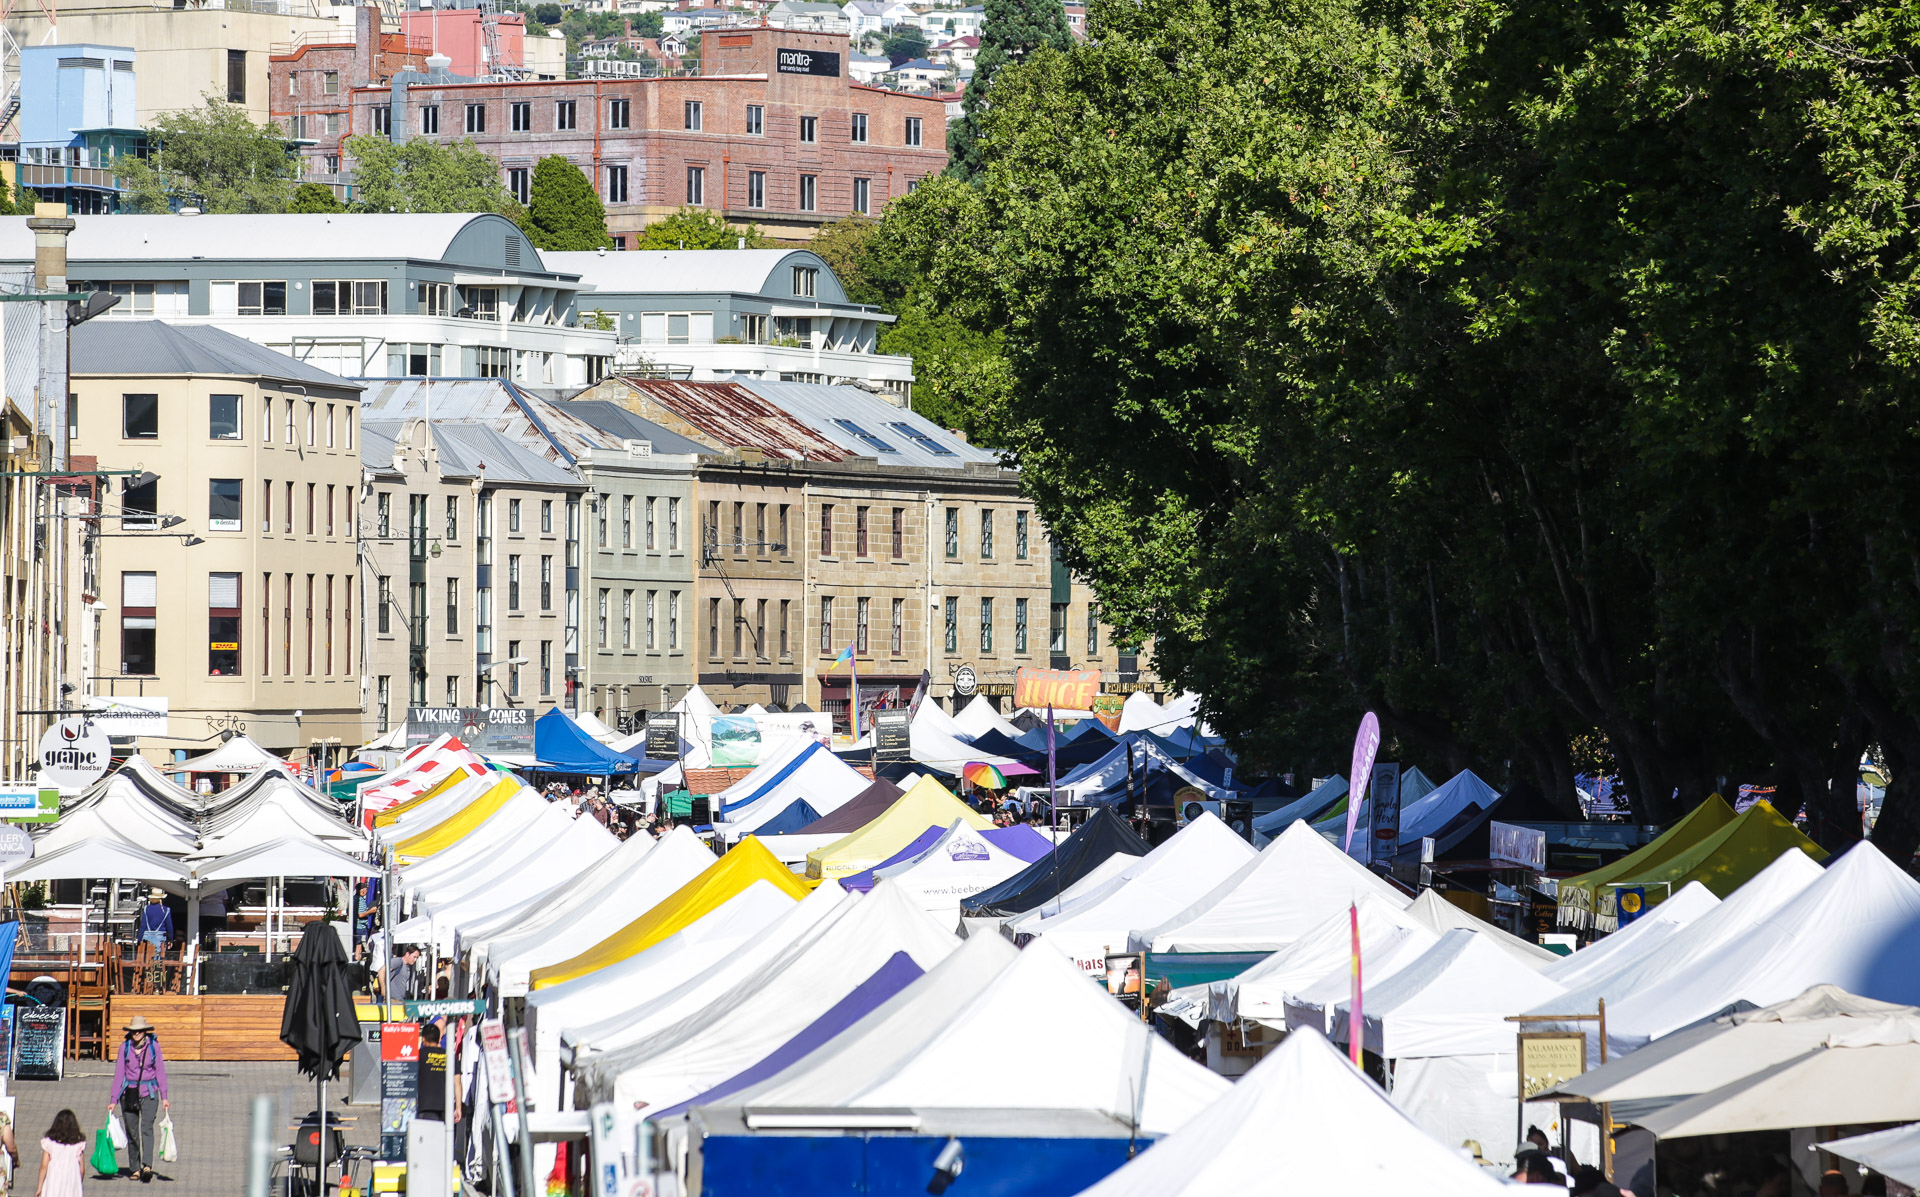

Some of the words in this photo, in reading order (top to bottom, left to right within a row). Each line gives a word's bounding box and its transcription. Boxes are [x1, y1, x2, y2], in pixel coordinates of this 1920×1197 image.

[780, 52, 813, 66] mantra
[1019, 680, 1092, 711] JUICE
[415, 708, 461, 723] VIKING
[488, 709, 527, 724] CONES
[45, 750, 97, 770] grape
[417, 1001, 476, 1015] VOUCHERS
[1527, 1044, 1578, 1052] SALAMANCA
